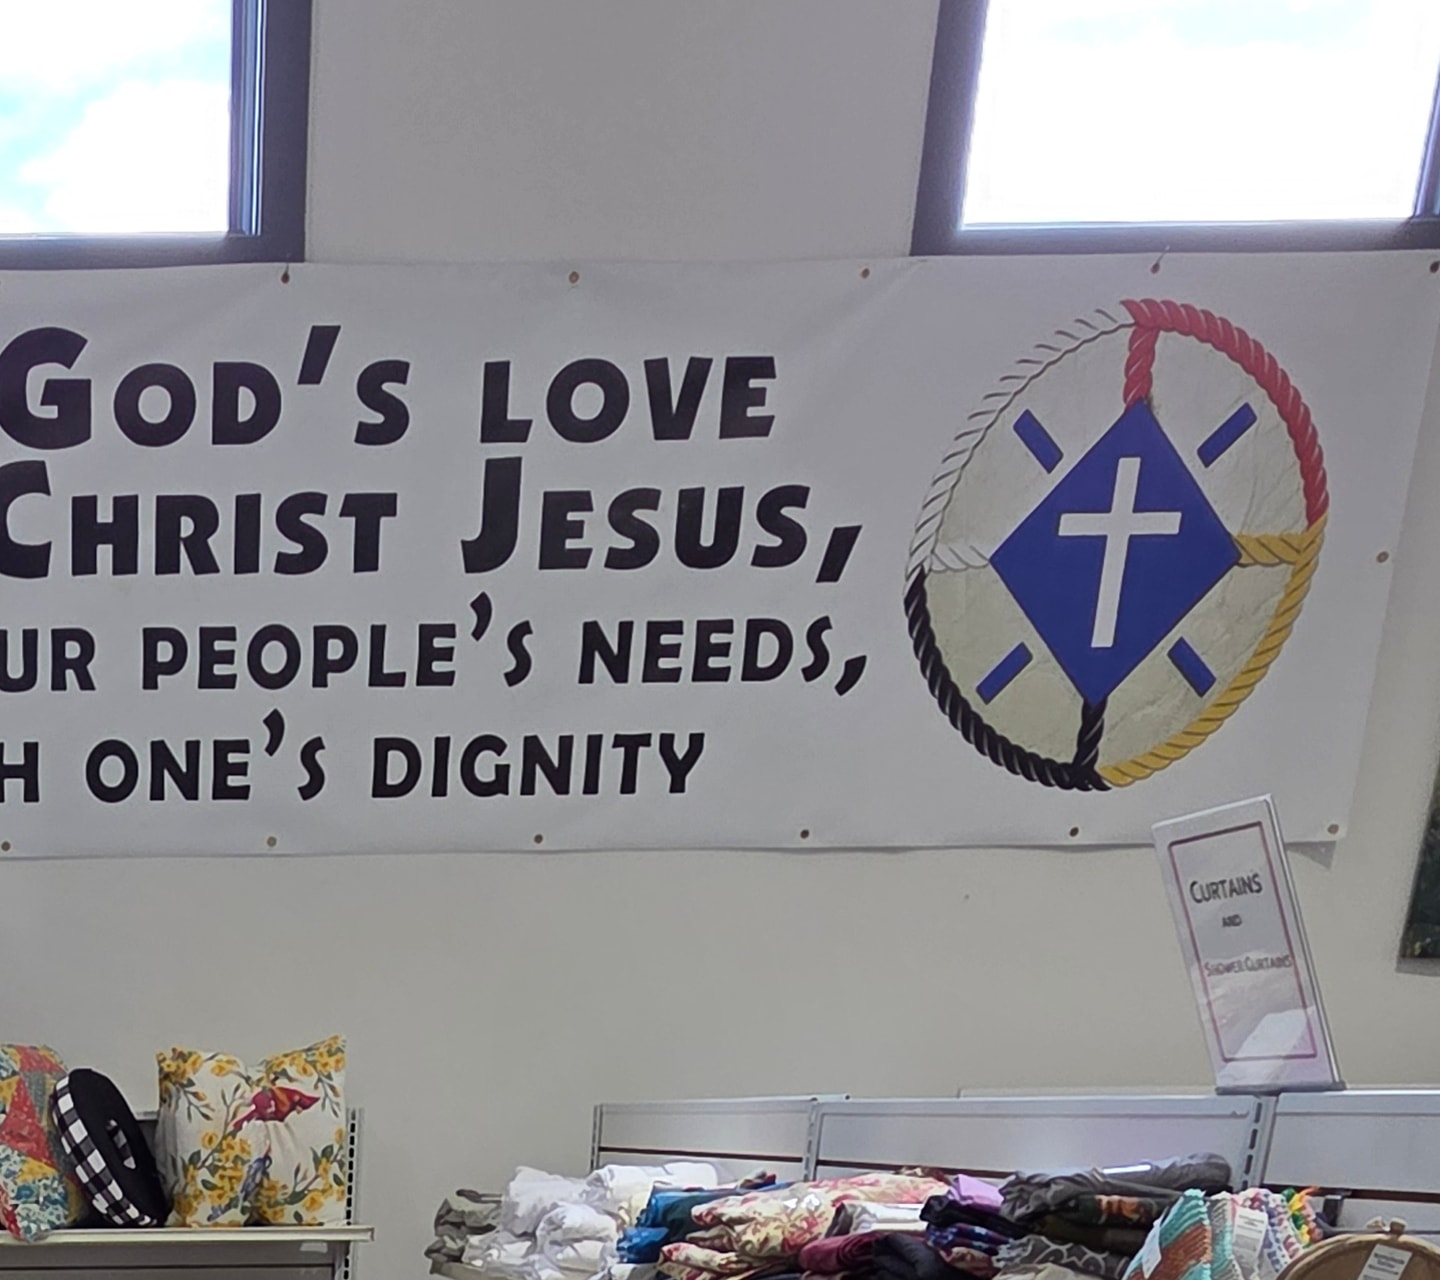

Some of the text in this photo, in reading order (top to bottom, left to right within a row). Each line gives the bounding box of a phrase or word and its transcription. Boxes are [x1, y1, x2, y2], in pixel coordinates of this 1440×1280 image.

[479, 355, 777, 444] LOVE
[460, 456, 863, 584] JESUS,
[142, 591, 534, 691] PEOPLE'S
[577, 615, 867, 697] NEEDS,
[85, 708, 326, 804] ONE'S
[371, 732, 706, 799] DIGNITY
[1189, 872, 1263, 904] CURTAINS
